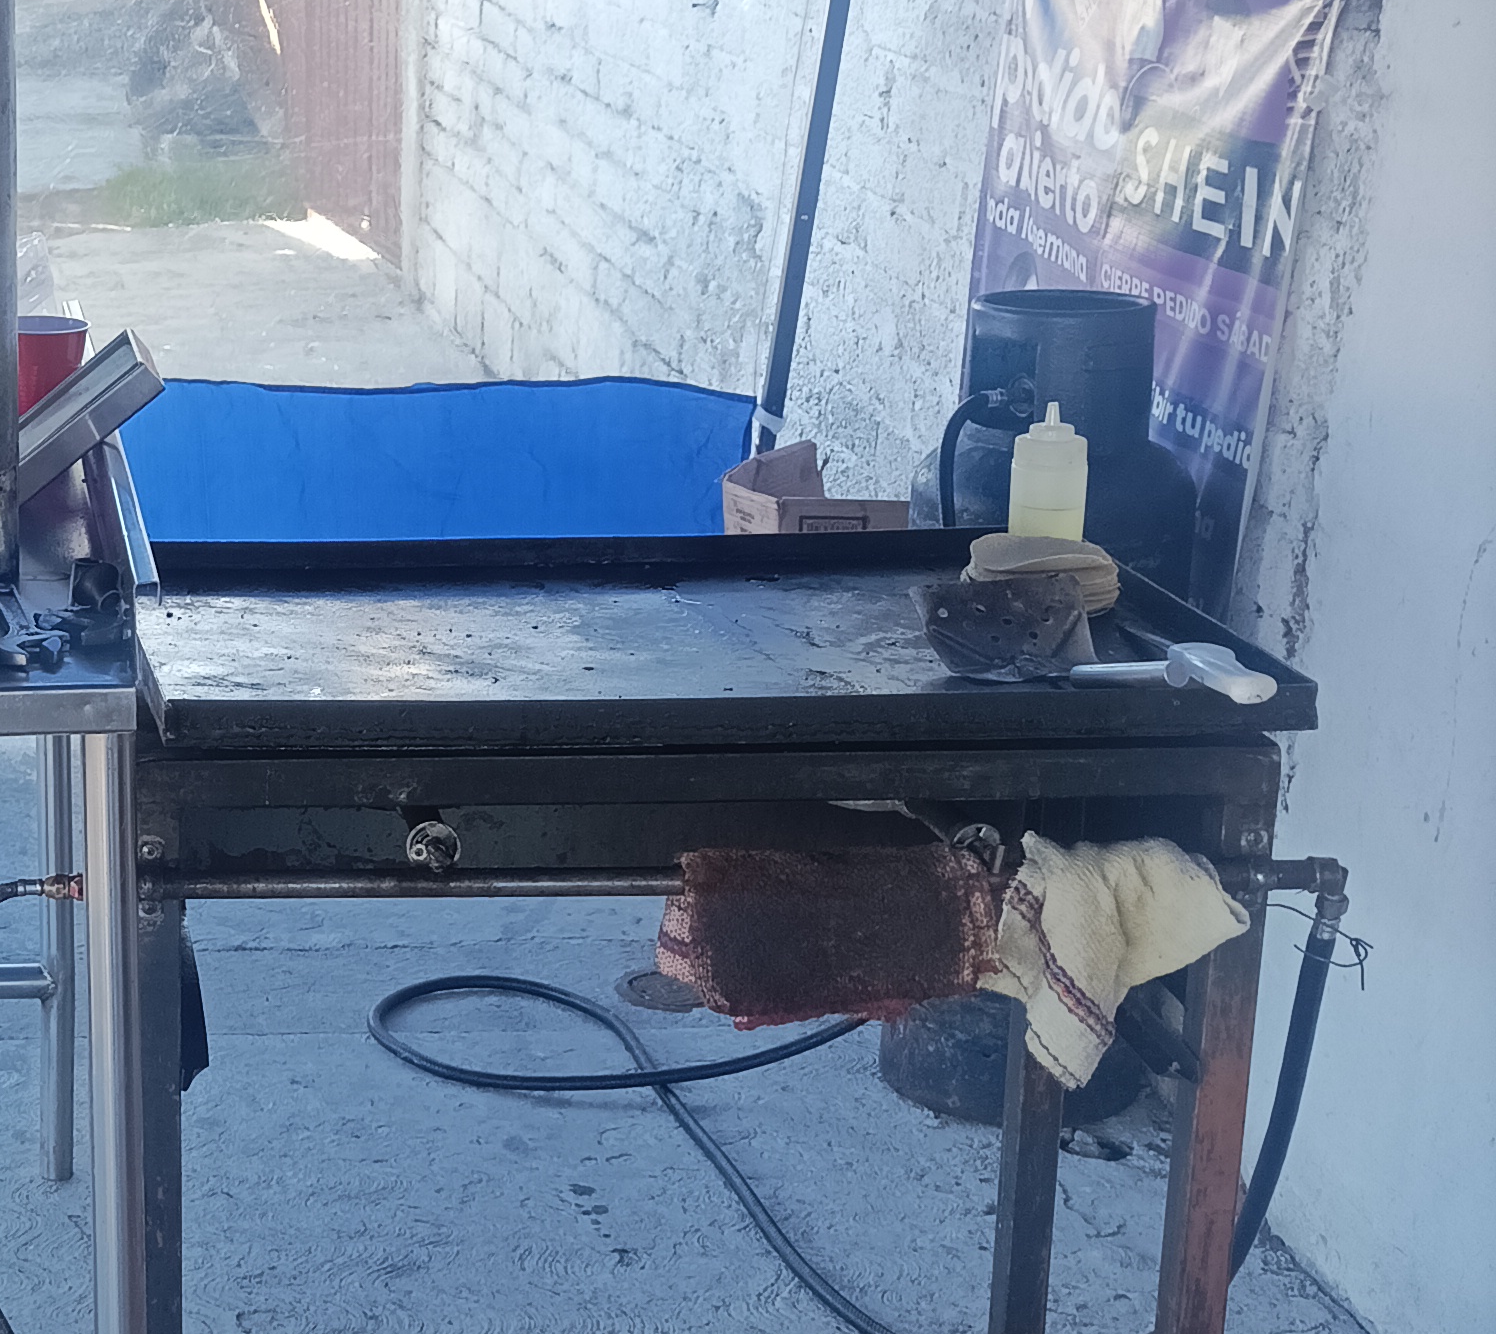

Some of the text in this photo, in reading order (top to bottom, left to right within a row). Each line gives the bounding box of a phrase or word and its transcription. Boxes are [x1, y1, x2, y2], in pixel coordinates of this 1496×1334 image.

[1125, 126, 1303, 257] SHEIN
[1153, 286, 1211, 335] PEDIDO
[1176, 403, 1203, 438] tu
